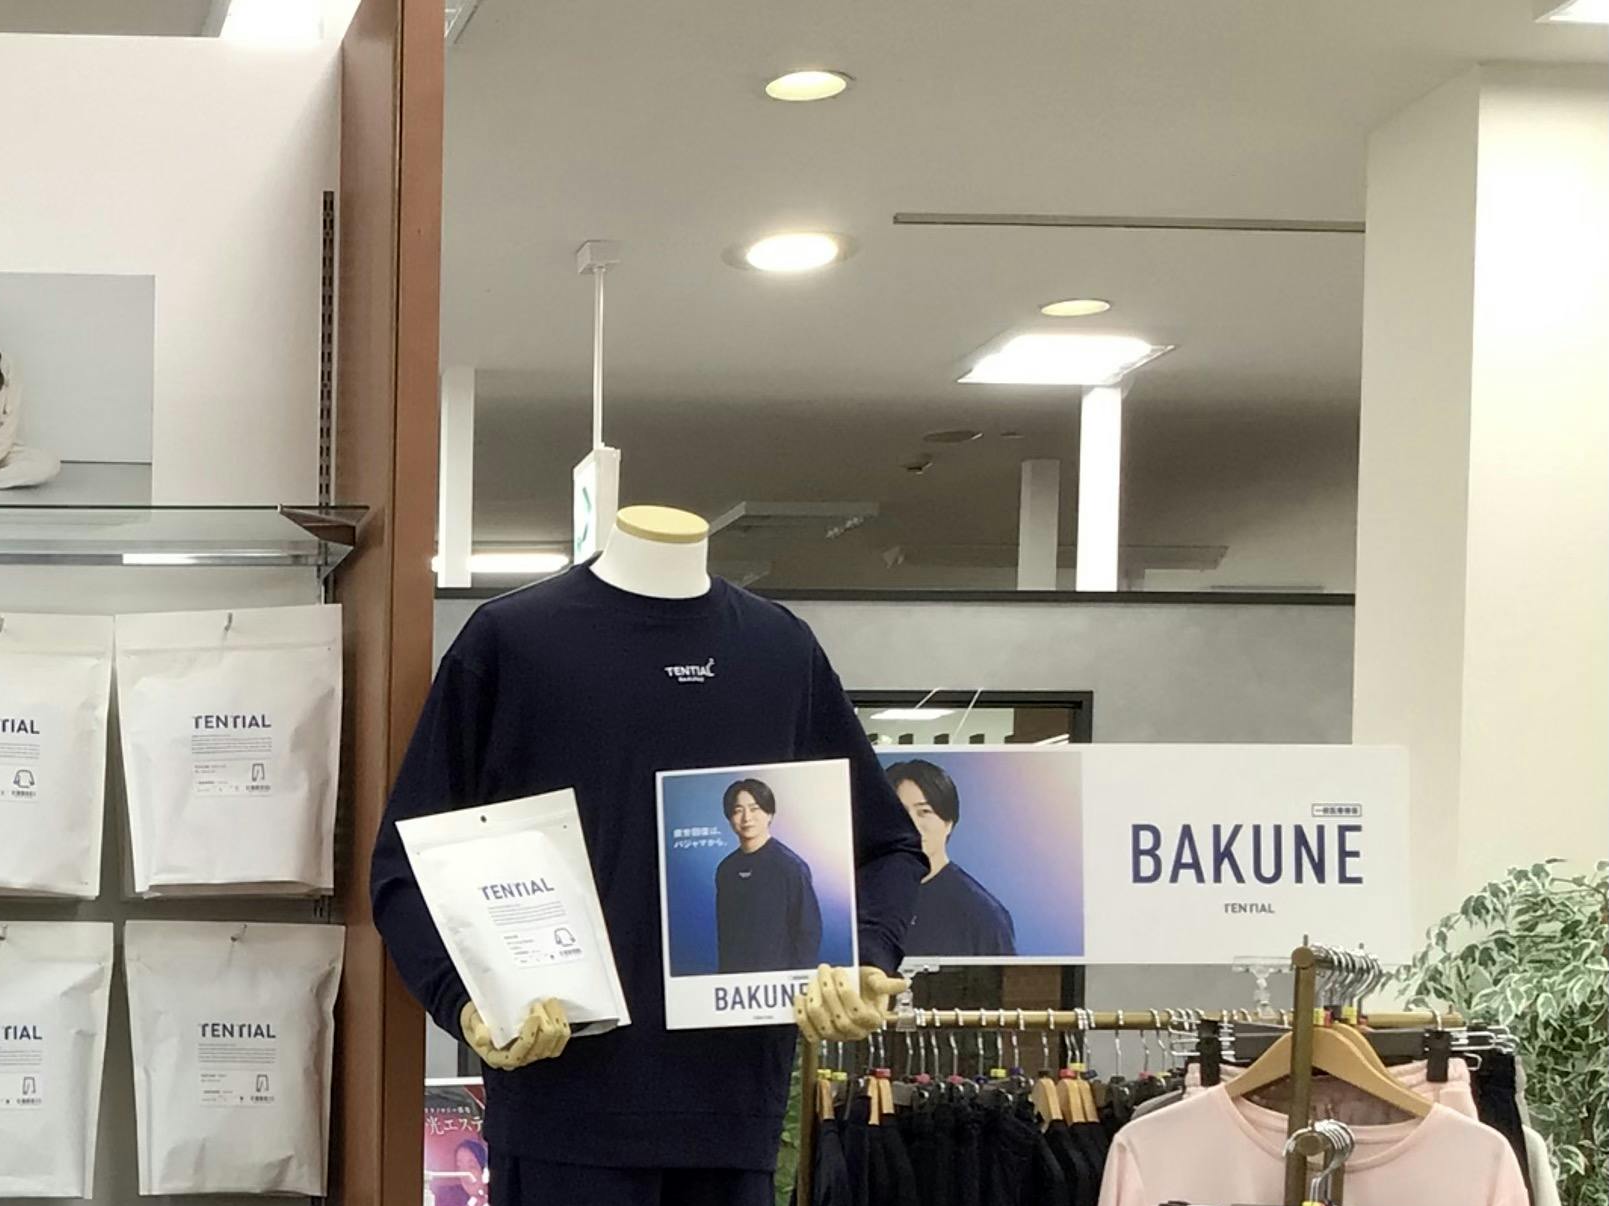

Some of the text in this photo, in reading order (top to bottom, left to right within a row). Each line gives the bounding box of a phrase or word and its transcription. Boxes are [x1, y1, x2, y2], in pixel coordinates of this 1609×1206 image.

[664, 662, 715, 677] TENTIAL
[192, 713, 272, 730] TENTIAL
[1131, 824, 1363, 884] BAKUNE
[479, 877, 555, 901] TENTIAL
[1223, 903, 1275, 914] TENTIAL
[199, 1022, 277, 1039] TENTIAL
